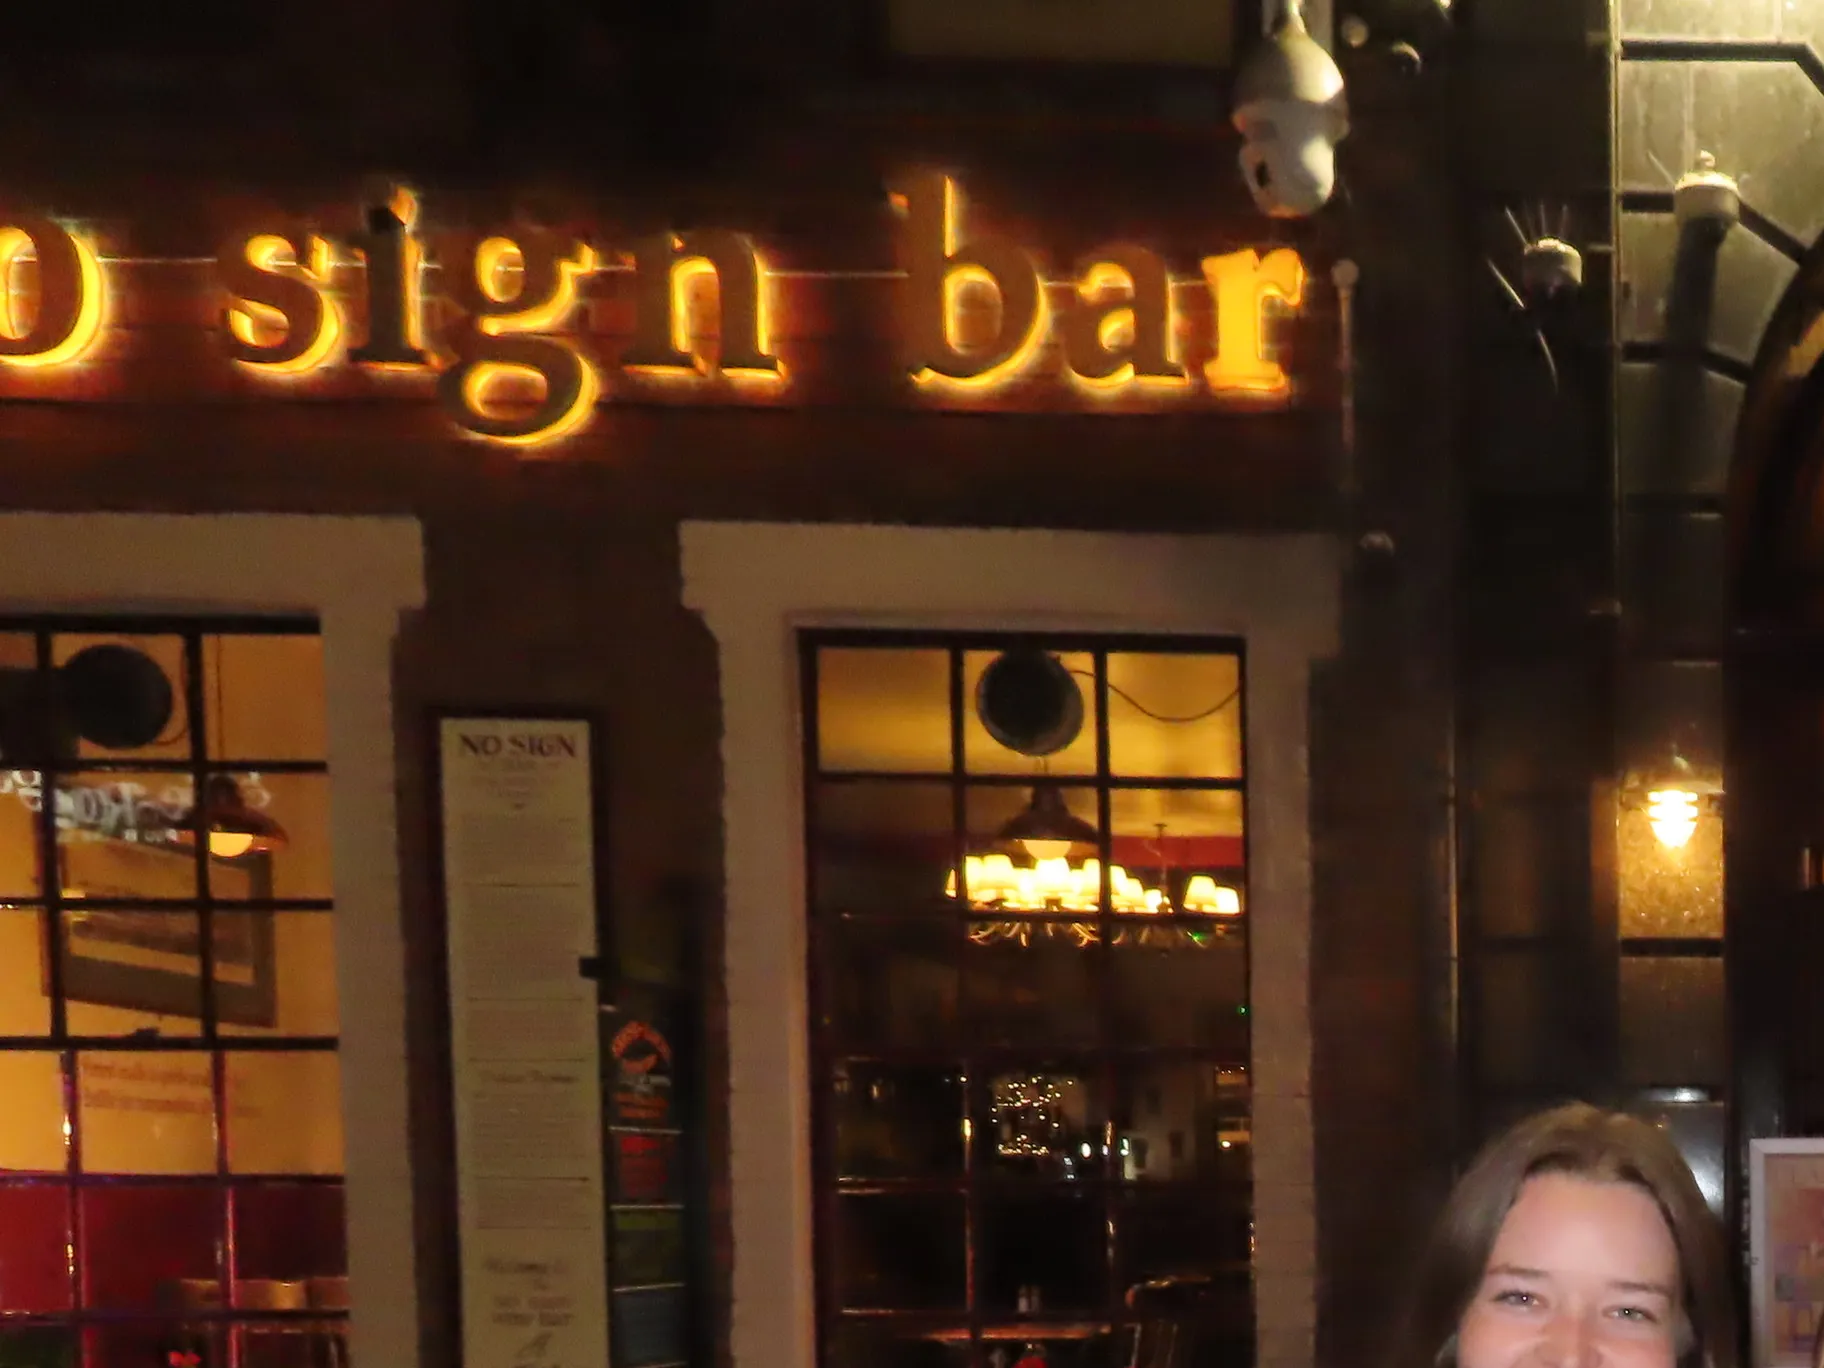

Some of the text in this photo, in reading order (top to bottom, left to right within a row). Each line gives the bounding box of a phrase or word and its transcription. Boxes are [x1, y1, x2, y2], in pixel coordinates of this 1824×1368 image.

[218, 186, 786, 447] sign
[889, 169, 1304, 394] bar
[459, 732, 578, 758] NO SIGN
